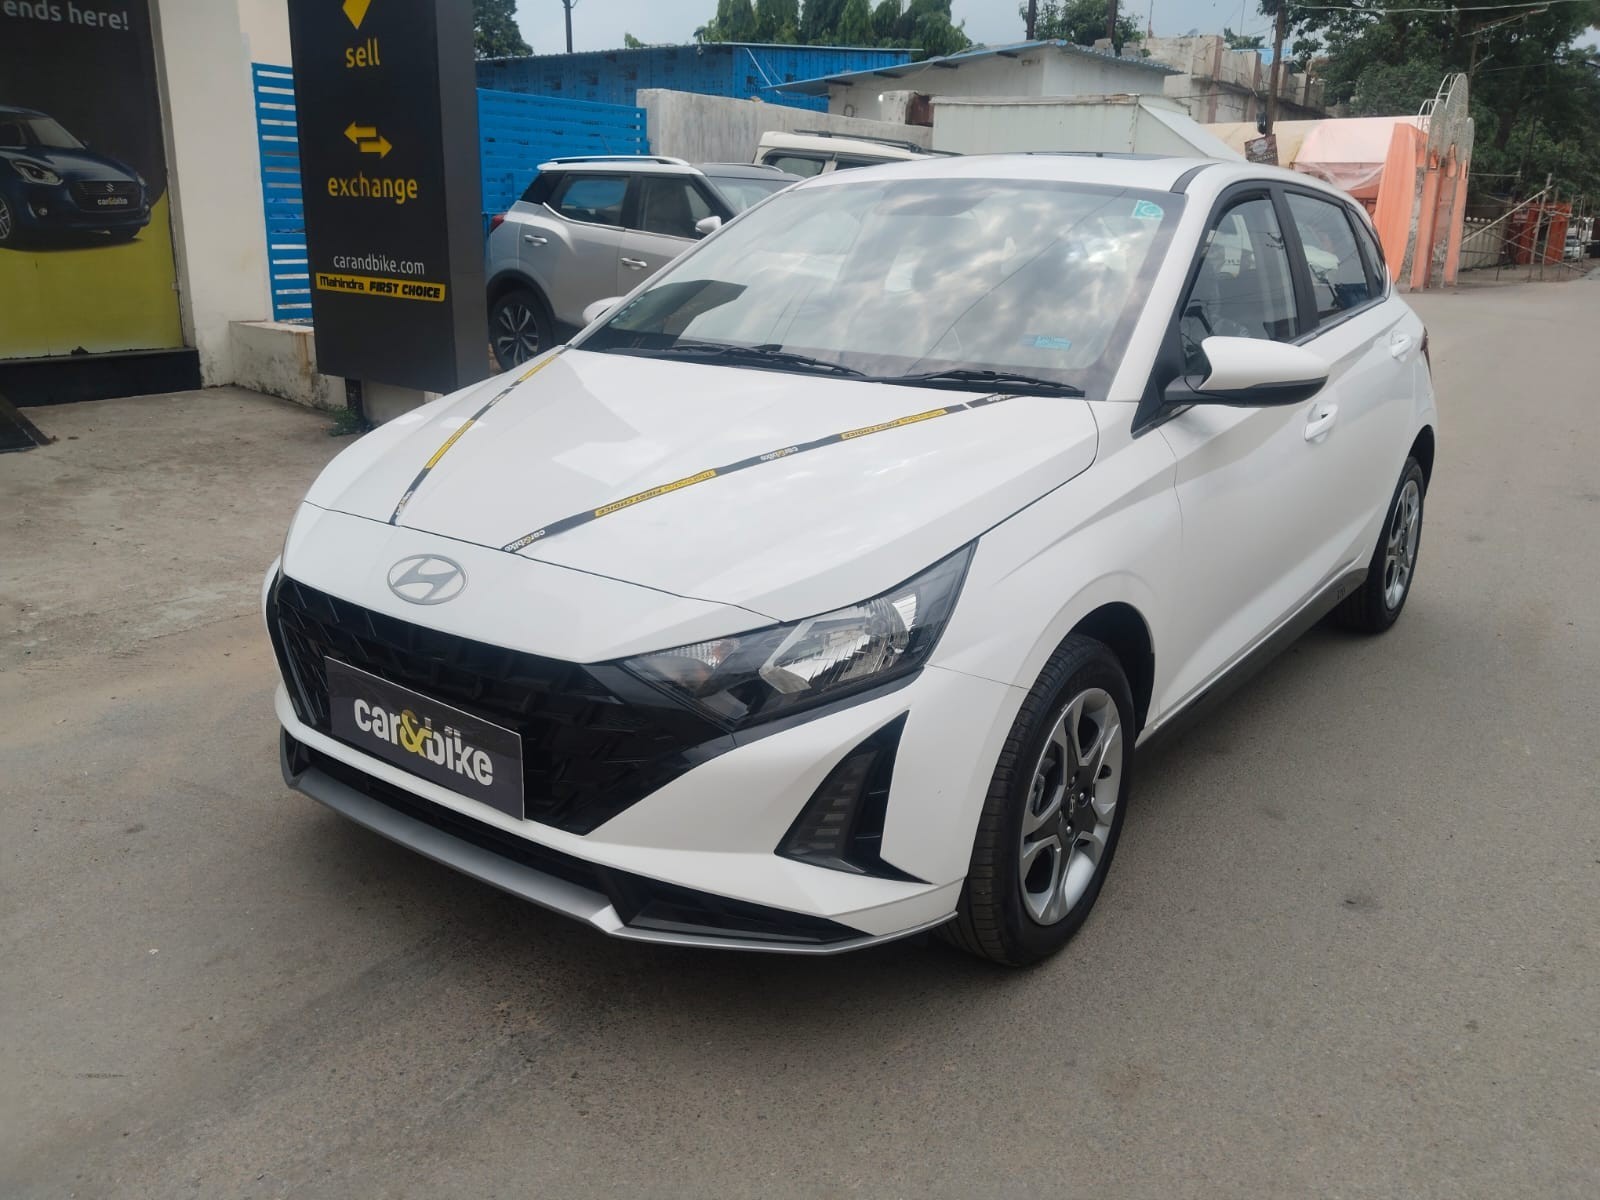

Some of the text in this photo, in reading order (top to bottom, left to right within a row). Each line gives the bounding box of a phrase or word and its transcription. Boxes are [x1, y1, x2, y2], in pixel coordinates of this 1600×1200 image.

[3, 0, 129, 31] ends here!
[345, 37, 381, 68] sell
[327, 170, 419, 205] exchange
[333, 253, 426, 275] carandbike.com
[319, 275, 441, 299] Mahindra FIRST CHOICE
[353, 698, 494, 786] car&bike
